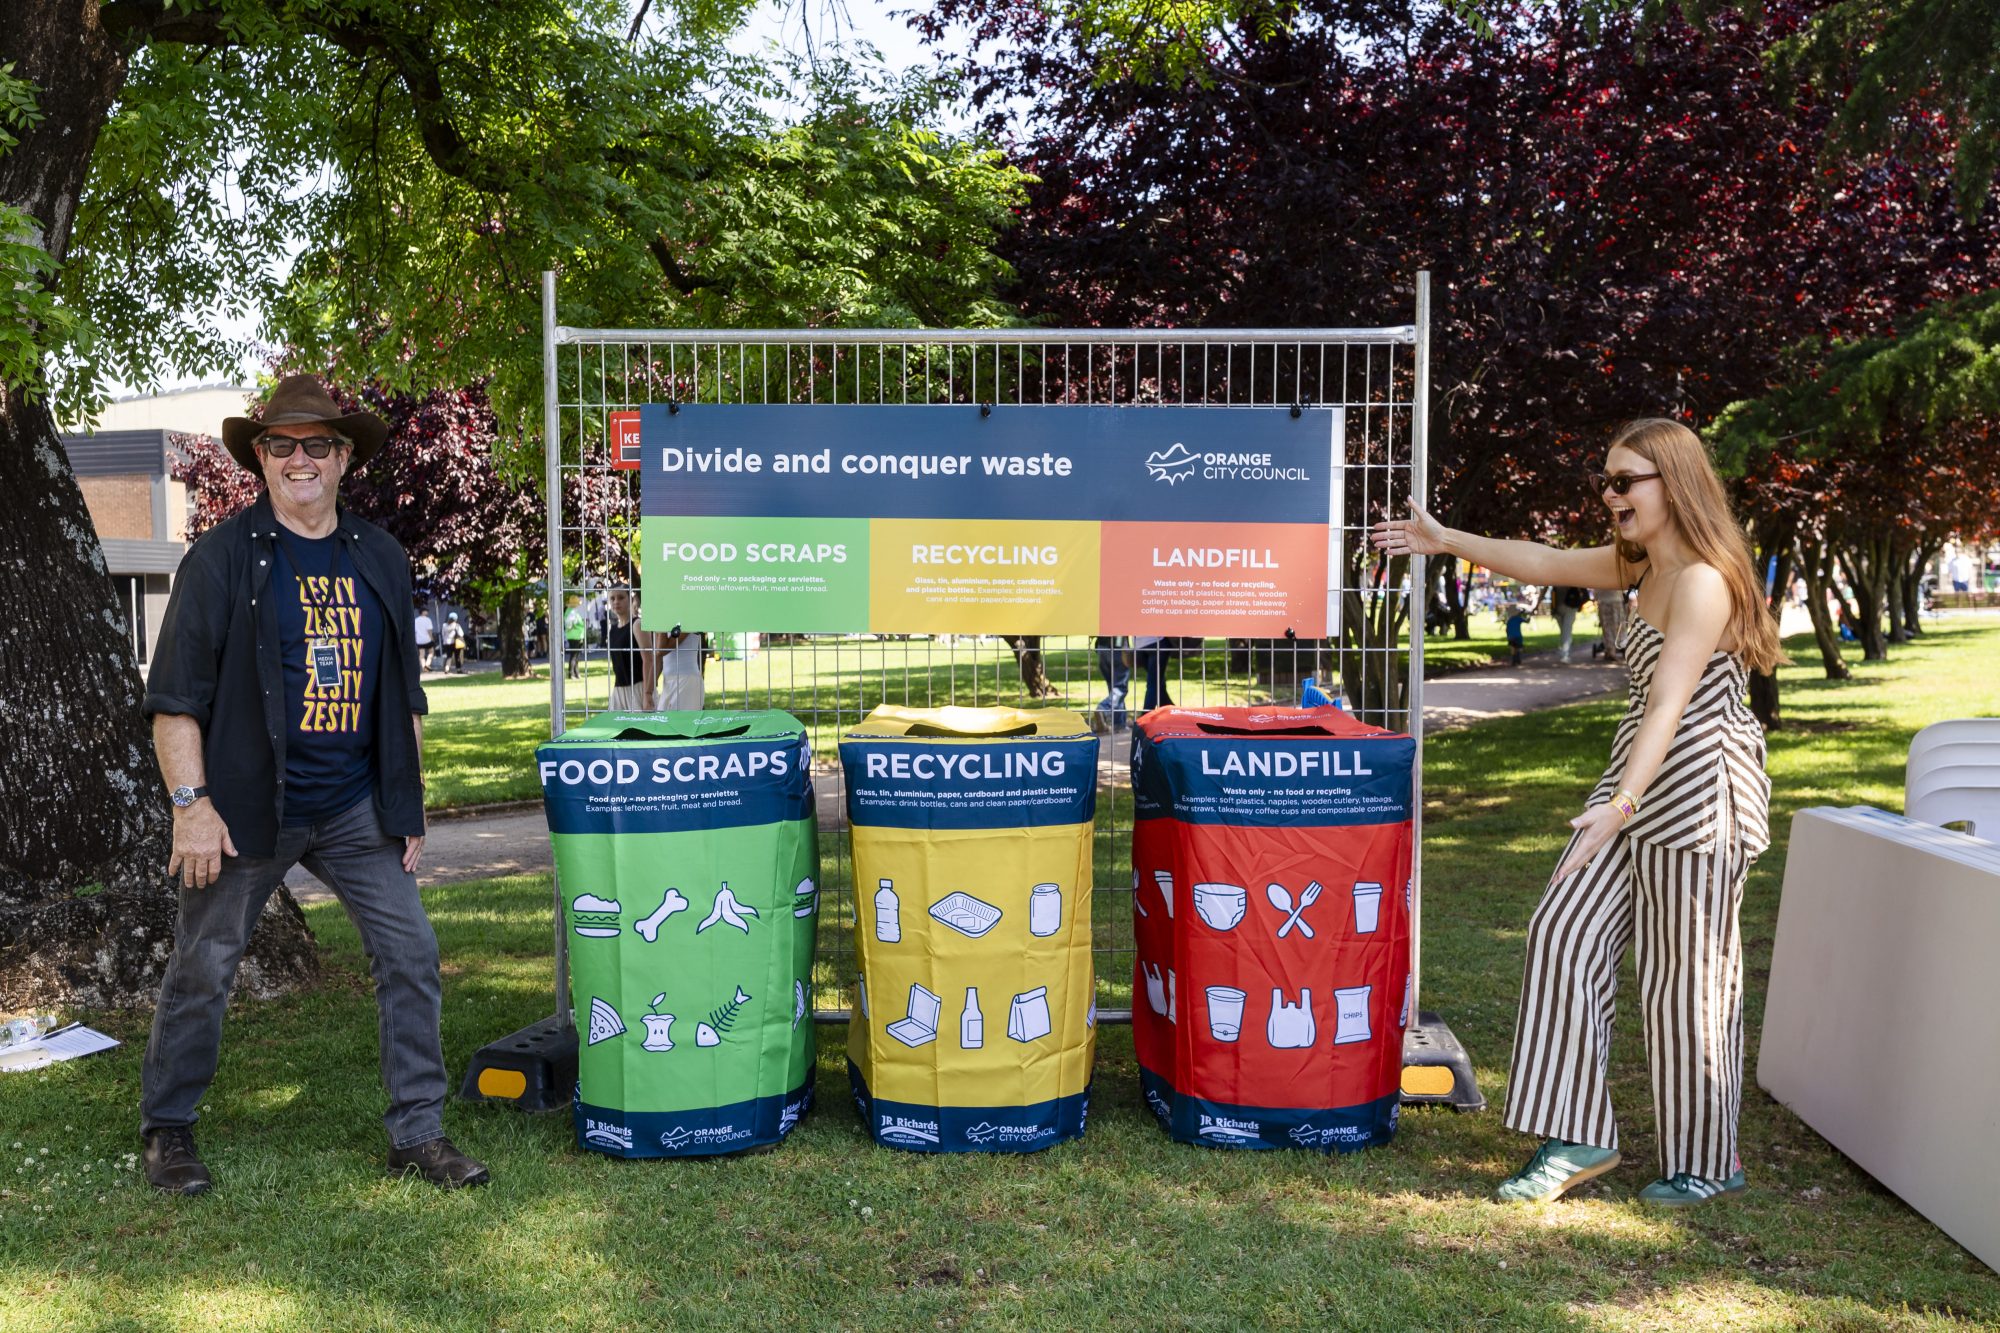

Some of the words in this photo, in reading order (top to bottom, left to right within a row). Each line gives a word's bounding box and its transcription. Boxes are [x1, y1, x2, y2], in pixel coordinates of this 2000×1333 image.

[662, 447, 762, 473] Divide
[773, 448, 831, 474] and
[841, 453, 972, 479] conquer
[981, 452, 1073, 477] waste
[1203, 453, 1271, 466] ORANGE
[1203, 467, 1238, 480] CITY
[1240, 468, 1310, 481] COUNCIL
[662, 542, 738, 562] FOOD
[746, 543, 847, 563] SCRAPS
[912, 544, 1058, 565] RECYCLING
[1152, 548, 1279, 568] LANDFILL
[705, 575, 720, 583] only
[739, 576, 776, 584] packaging
[915, 577, 936, 585] Glass,
[938, 577, 950, 585] tin,
[1017, 578, 1055, 586] cardboard
[1178, 580, 1193, 588] only
[1241, 581, 1276, 589] recycling.
[681, 584, 716, 592] Examples:
[718, 584, 751, 592] leftovers,
[752, 584, 768, 592] fruit,
[977, 587, 1013, 595] Examples:
[1142, 589, 1178, 597] Examples:
[1227, 590, 1256, 598] nappies,
[1259, 590, 1288, 598] wooden
[1170, 599, 1201, 607] teabags,
[1252, 600, 1286, 608] takeaway
[1141, 607, 1164, 615] coffee
[1199, 608, 1246, 616] compostable
[1248, 608, 1288, 616] containers.
[300, 701, 361, 732] ZESTY
[540, 759, 640, 786] FOOD
[651, 750, 788, 783] SCRAPS
[866, 750, 1065, 780] RECYCLING
[1201, 750, 1372, 777] LANDFILL
[648, 794, 688, 803] packaging
[700, 790, 739, 798] serviettes
[894, 790, 936, 798] aluminium,
[937, 791, 962, 799] paper,
[964, 790, 1004, 798] cardboard
[1022, 788, 1048, 797] plastic
[1249, 788, 1265, 796] only
[1316, 788, 1351, 796] recycling
[585, 805, 623, 813] Examples:
[625, 803, 659, 811] leftovers,
[681, 801, 701, 809] meat
[702, 800, 717, 808] and
[718, 798, 742, 806] bread.
[860, 798, 897, 806] Examples:
[920, 800, 948, 808] bottles,
[986, 799, 1006, 807] clean
[1008, 796, 1072, 807] paper/cardboard.
[1181, 795, 1218, 803] Examples:
[1236, 797, 1266, 805] plastics,
[1268, 798, 1300, 806] nappies,
[1218, 806, 1253, 815] takeaway
[1255, 807, 1279, 815] coffee
[1301, 807, 1315, 815] and
[1317, 806, 1365, 815] compostable
[586, 1118, 596, 1130] JR
[598, 1121, 632, 1136] Richards
[881, 1115, 893, 1126] JR
[897, 1117, 938, 1130] Richards
[1200, 1114, 1213, 1126] JR
[1216, 1117, 1260, 1130] Richards
[694, 1125, 733, 1137] ORANGE
[999, 1124, 1038, 1134] ORANGE
[999, 1133, 1020, 1142] CITY
[1020, 1127, 1056, 1142] COUNCIL
[1321, 1126, 1358, 1137] ORANGE
[694, 1134, 716, 1145] CITY
[716, 1129, 752, 1144] COUNCIL
[1321, 1135, 1340, 1144] CITY
